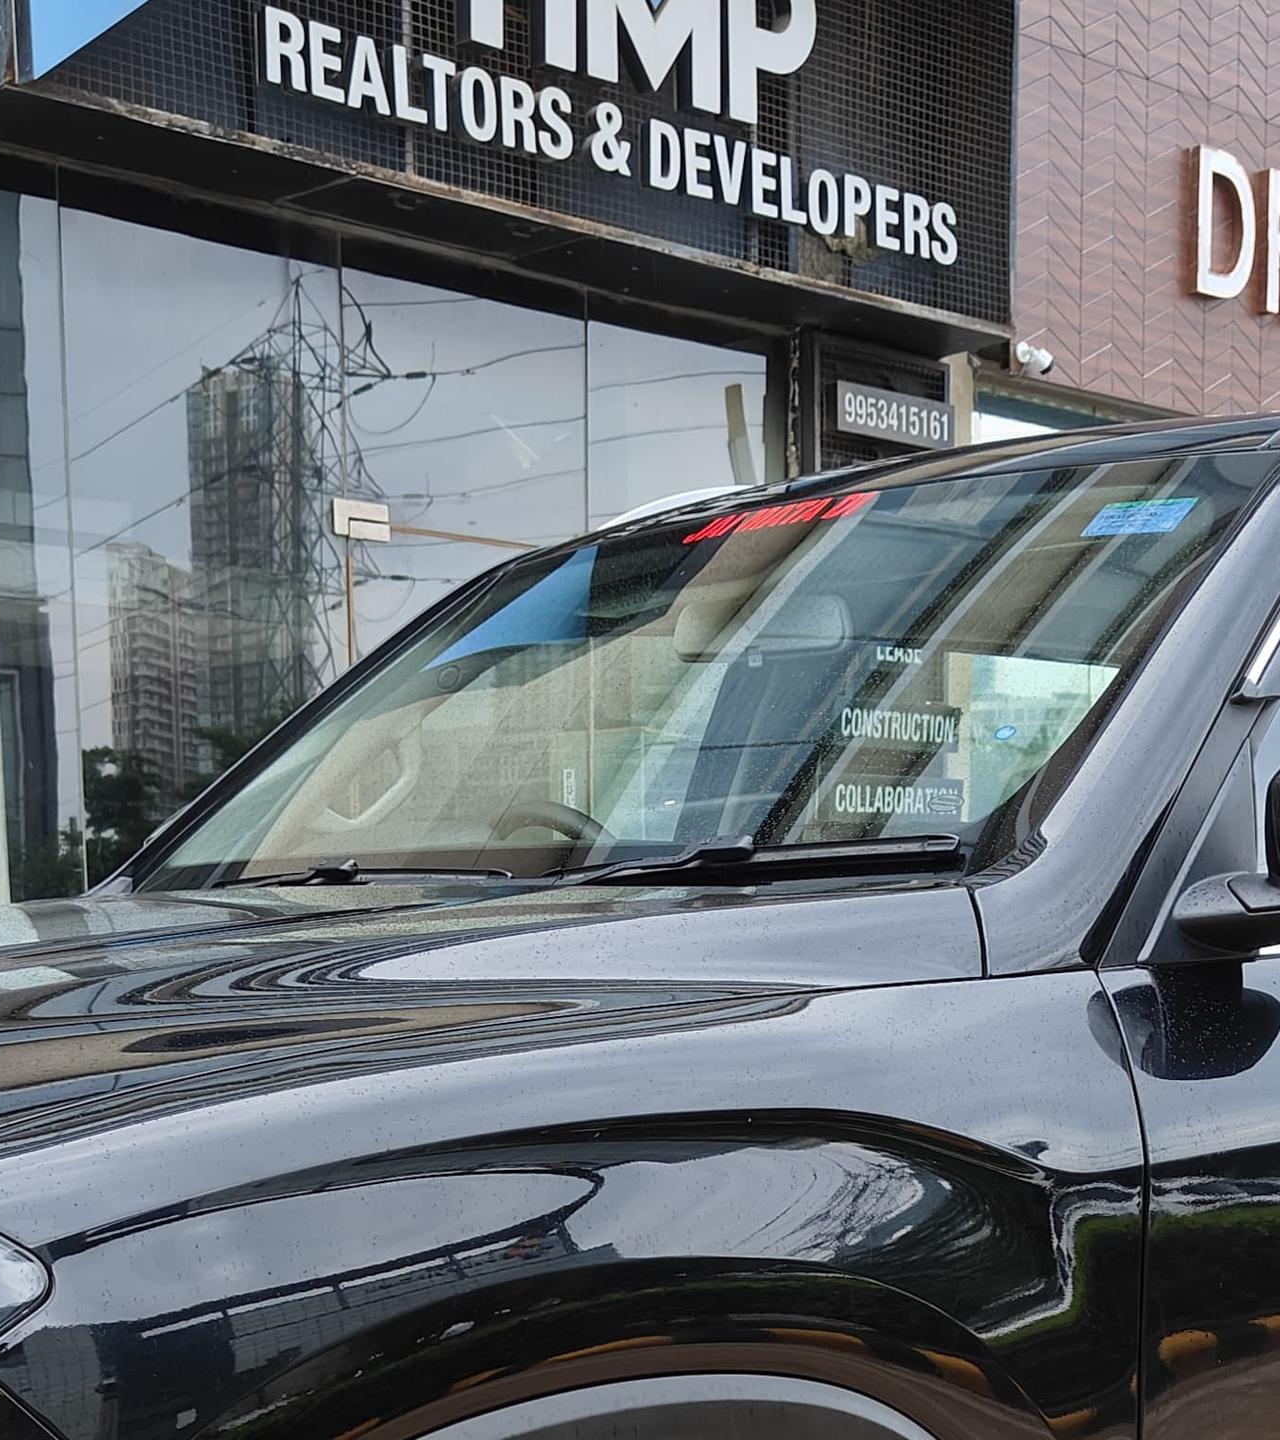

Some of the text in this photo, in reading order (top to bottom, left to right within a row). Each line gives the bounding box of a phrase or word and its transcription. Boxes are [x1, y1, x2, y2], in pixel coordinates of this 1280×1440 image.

[265, 5, 958, 266] REALTORS & DEVELOPERS
[845, 392, 949, 442] 9953415161
[841, 707, 955, 744] CONSTRUCTION
